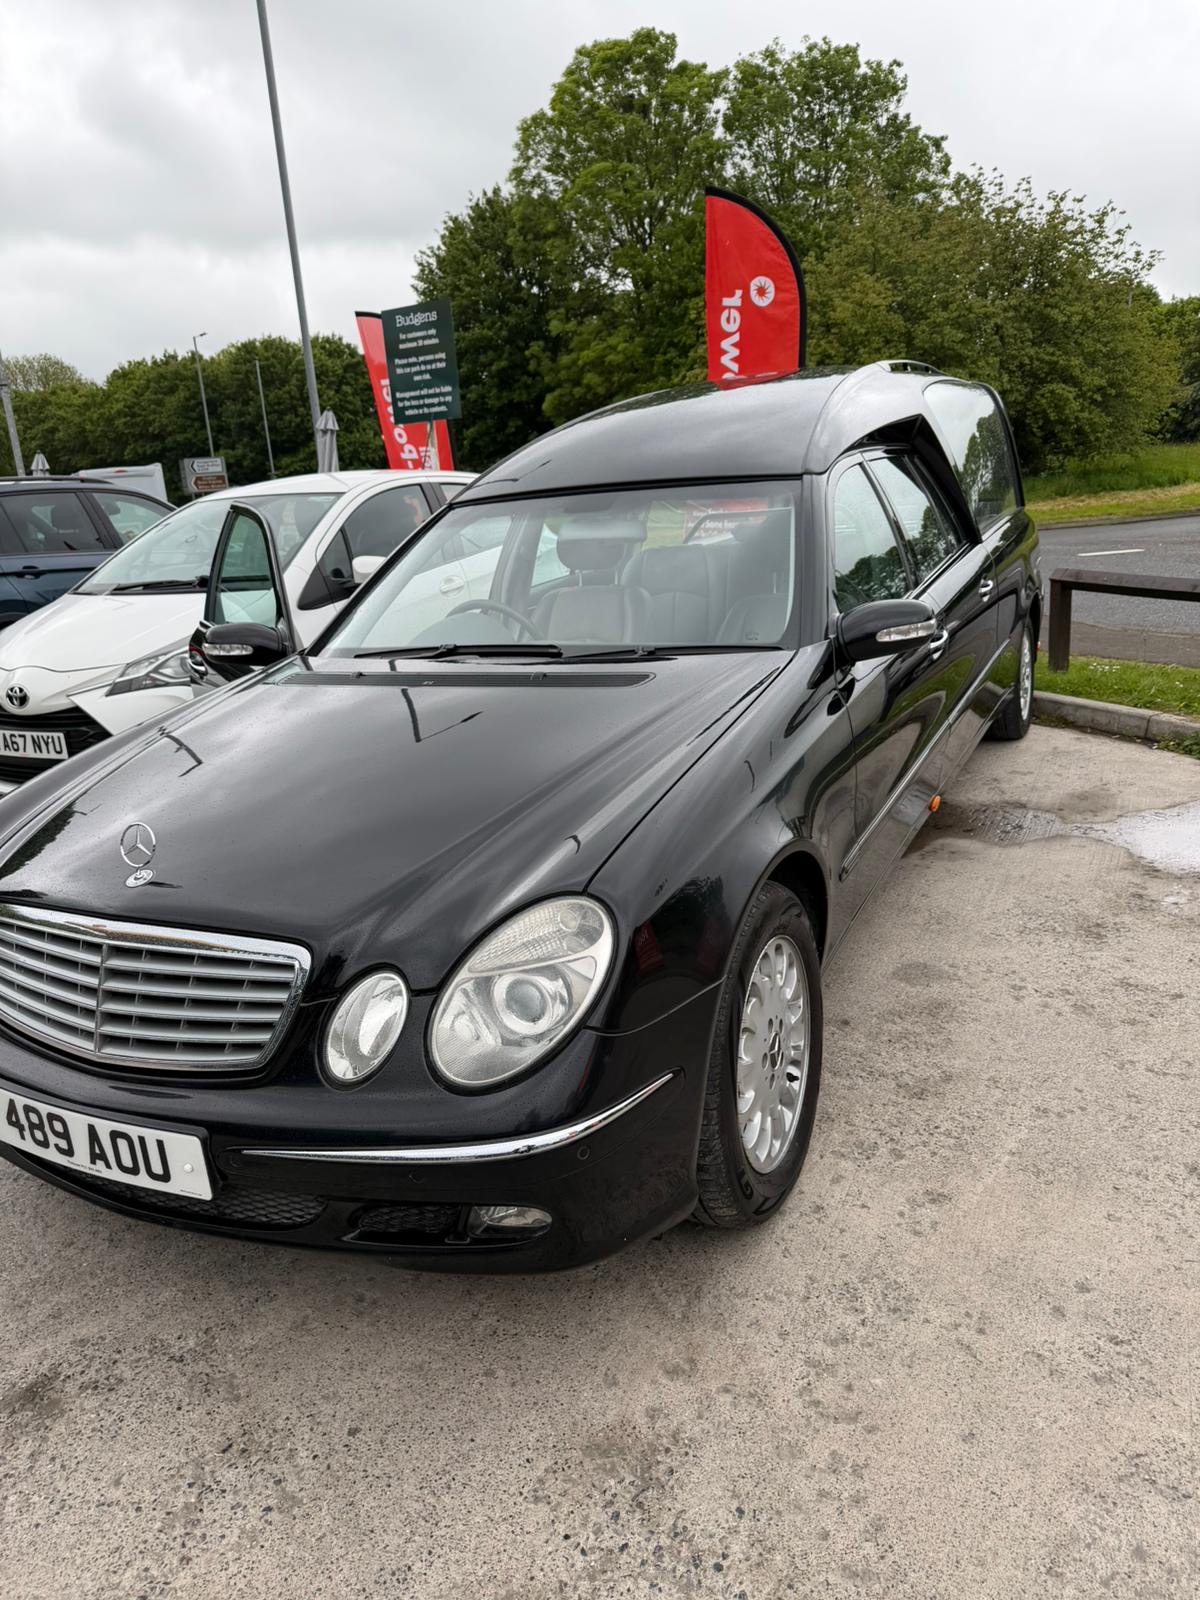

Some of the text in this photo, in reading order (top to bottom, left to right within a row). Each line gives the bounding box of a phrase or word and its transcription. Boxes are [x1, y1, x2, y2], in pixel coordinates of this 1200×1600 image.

[395, 311, 438, 327] Budgens
[406, 331, 427, 339] customers
[427, 328, 437, 336] only
[434, 352, 446, 360] using
[411, 365, 420, 374] park
[395, 391, 420, 399] Management
[0, 732, 64, 755] A67 NYU
[6, 1098, 171, 1183] 489 AOU
